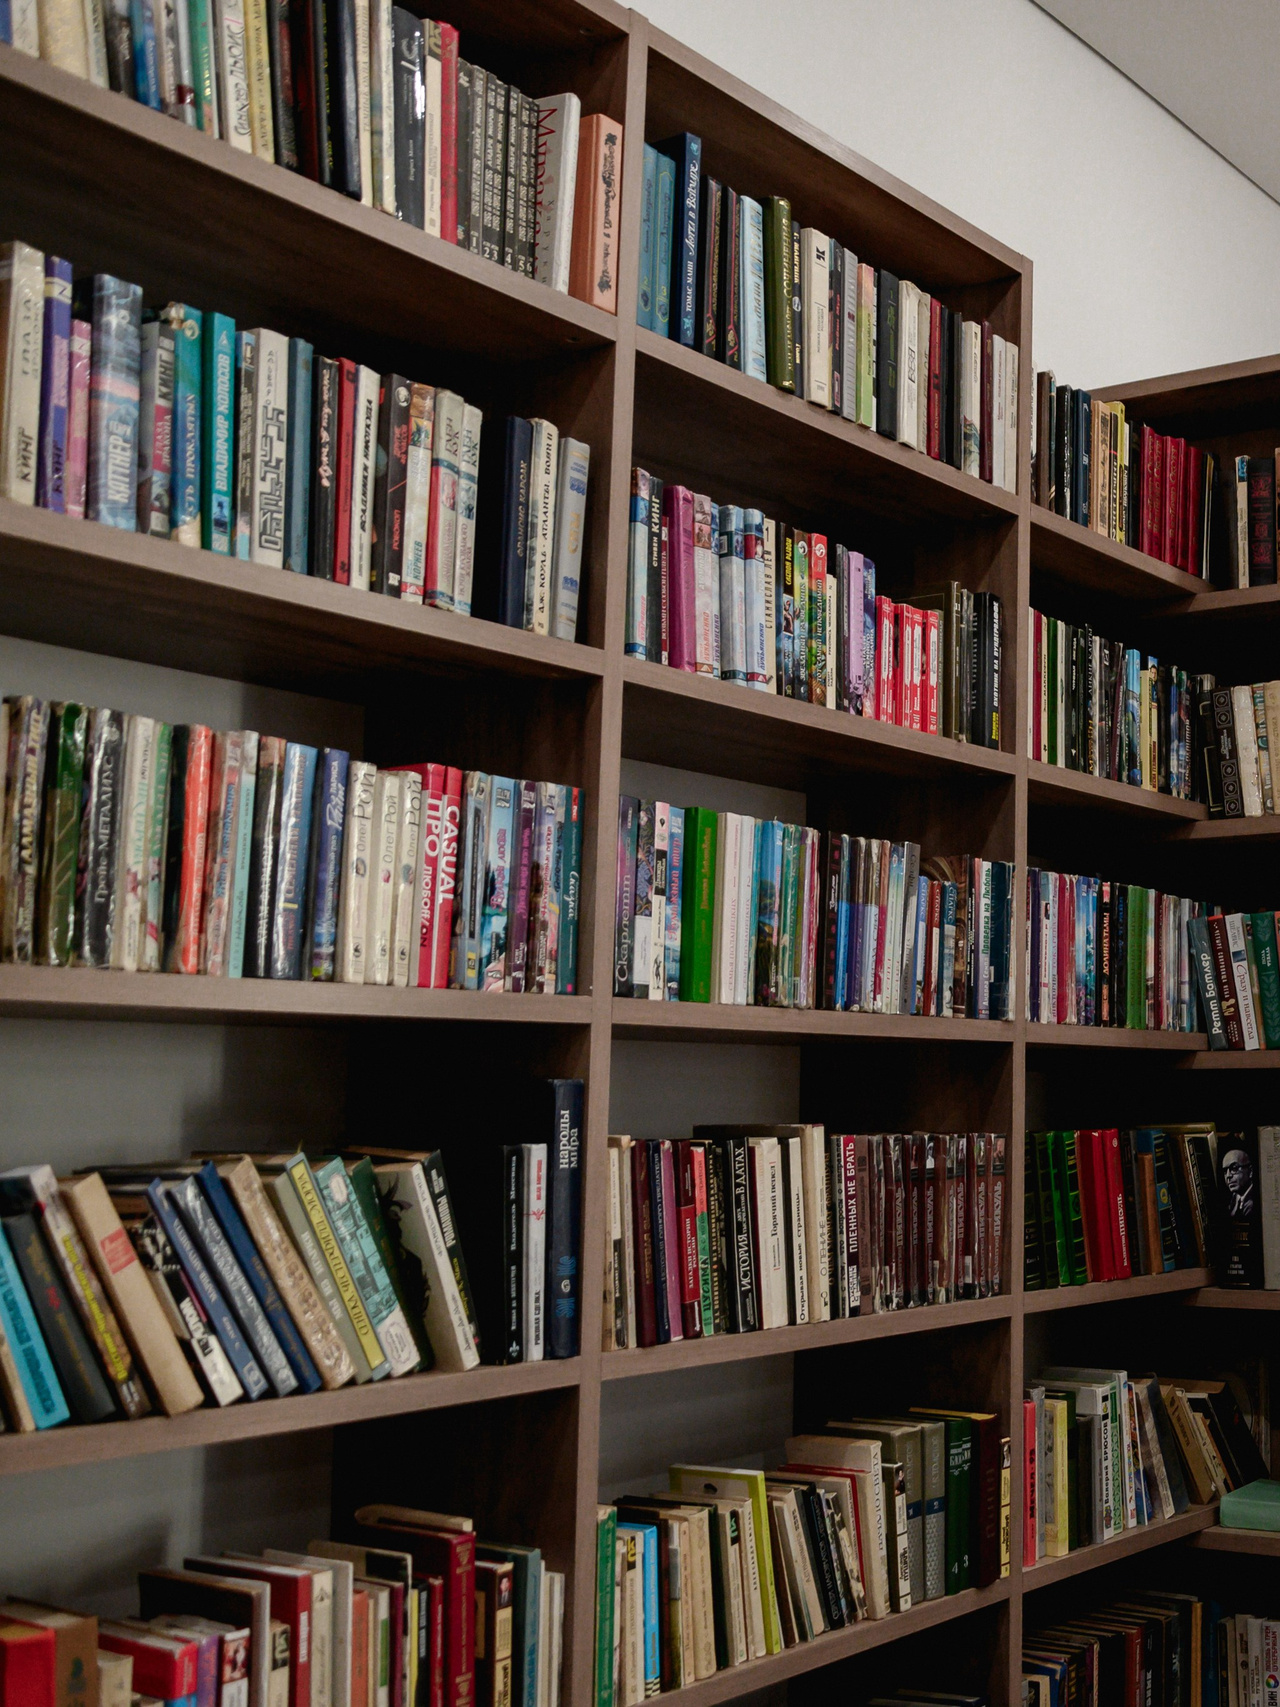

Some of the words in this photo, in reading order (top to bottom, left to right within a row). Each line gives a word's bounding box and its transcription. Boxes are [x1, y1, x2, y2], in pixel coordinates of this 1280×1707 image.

[157, 352, 173, 402] КИНГ
[650, 494, 661, 534] КИНГ
[438, 804, 460, 905] CASUAL
[1200, 952, 1215, 998] Батлер
[1208, 998, 1223, 1035] Ретт
[559, 1109, 571, 1169] народы
[569, 1127, 580, 1169] мира
[844, 1142, 856, 1177] БРАТЬ
[735, 1146, 747, 1185] ДАТАХ
[847, 1179, 856, 1195] НЕ
[735, 1186, 745, 1194] В
[436, 1195, 458, 1248] РОМАНОВЫ
[847, 1197, 859, 1253] ПЛЕННЫХ
[737, 1232, 752, 1292] ИСТОРИЯ
